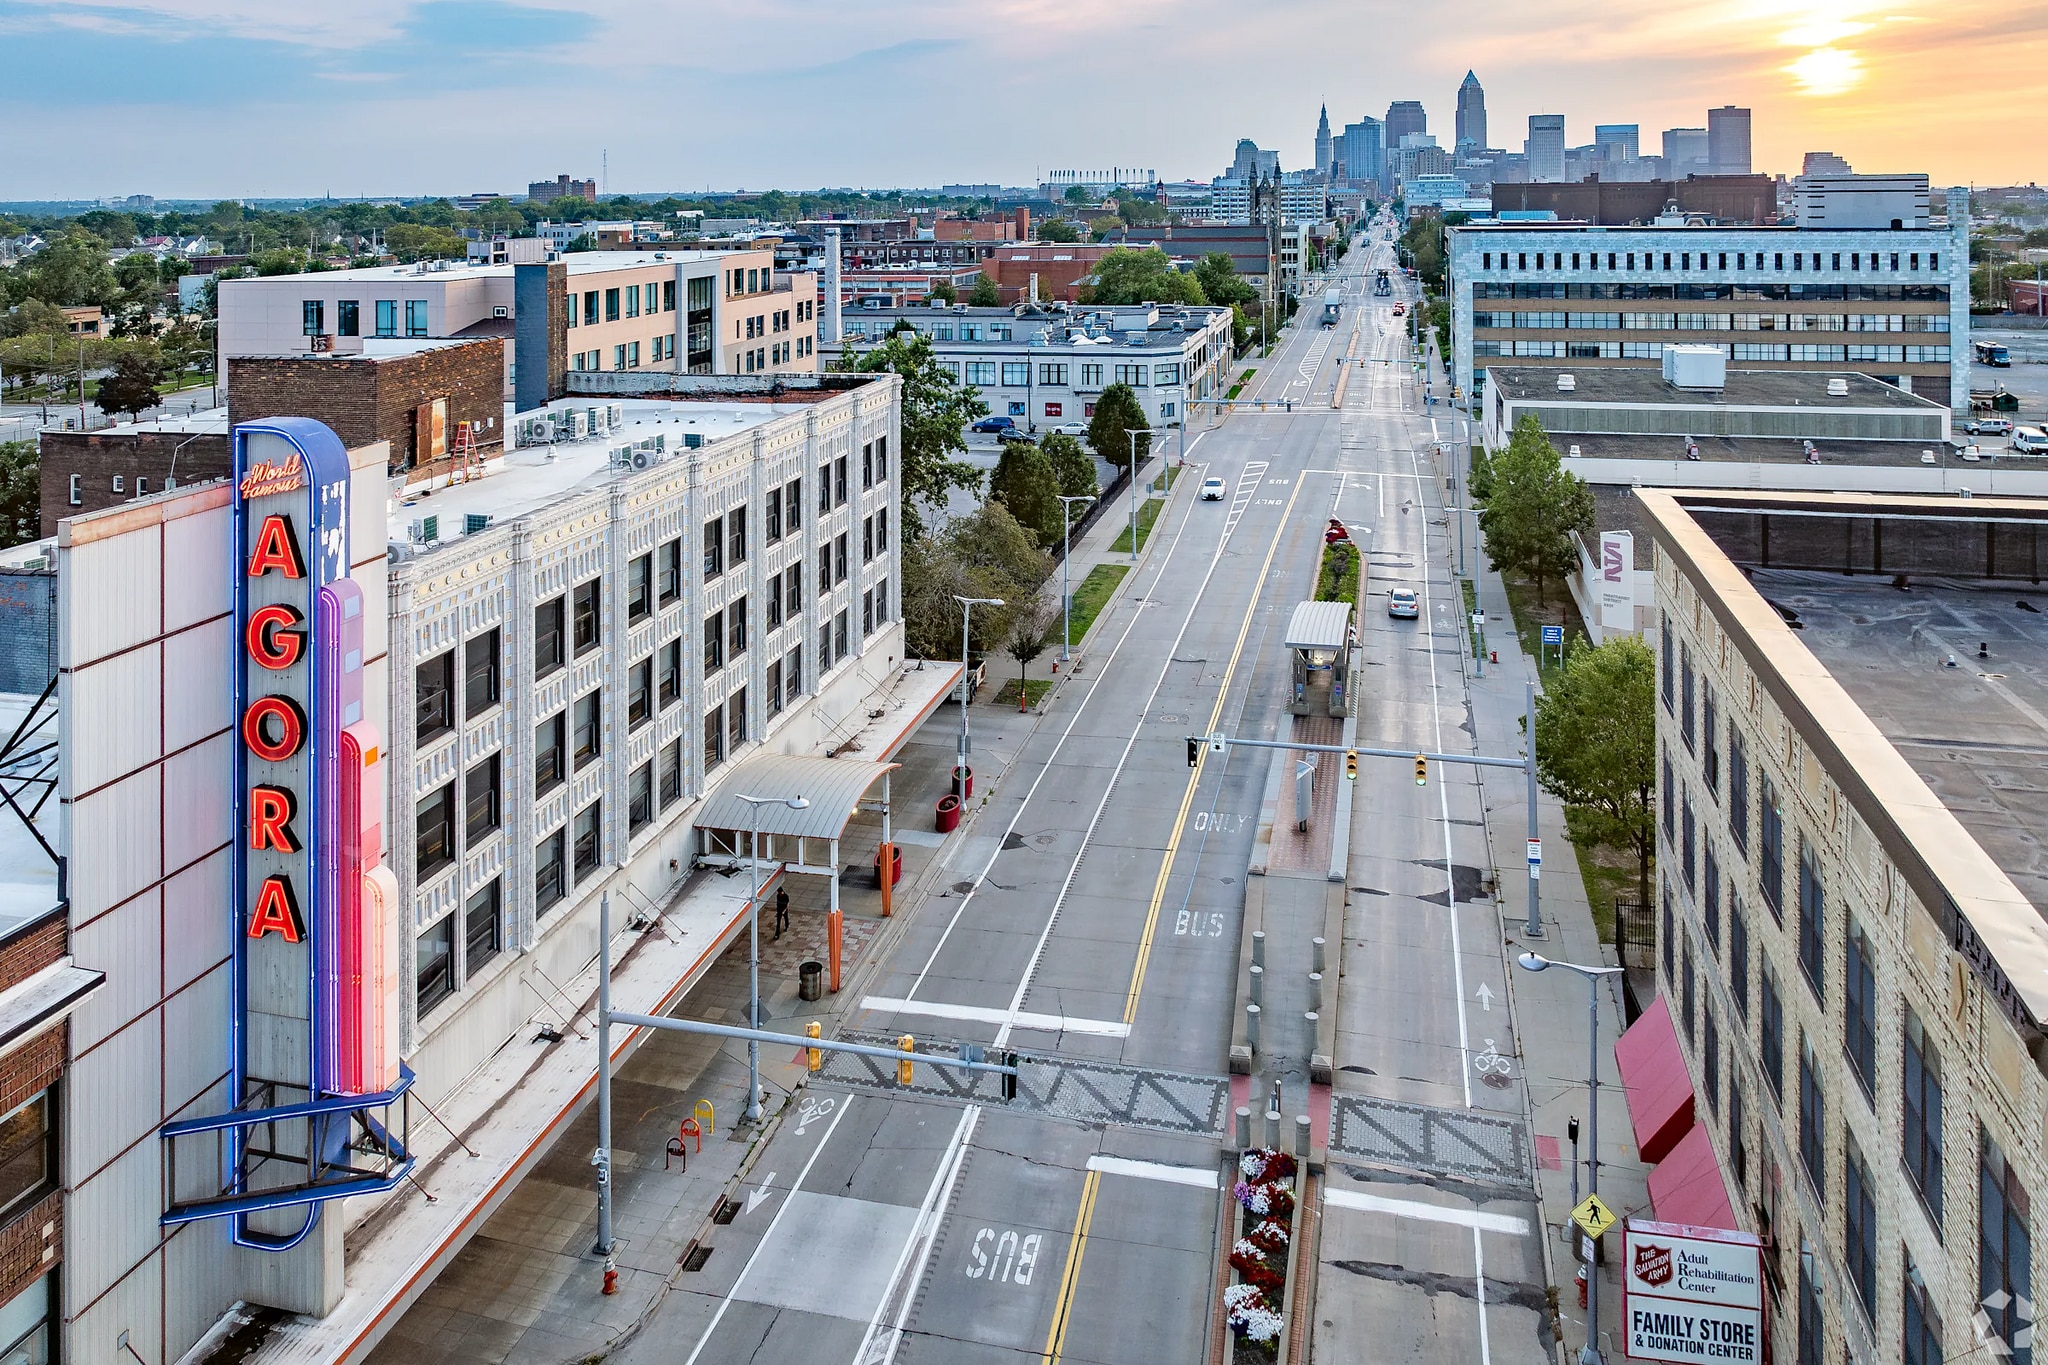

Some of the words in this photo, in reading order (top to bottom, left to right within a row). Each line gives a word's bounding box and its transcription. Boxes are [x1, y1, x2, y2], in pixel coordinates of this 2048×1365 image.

[252, 453, 301, 484] World
[240, 476, 301, 499] Famous
[244, 514, 307, 944] AGORA
[1194, 811, 1252, 834] ONLY
[1174, 909, 1224, 938] BUS
[965, 1227, 1043, 1286] BUS
[1635, 1252, 1670, 1276] SALVATION
[1640, 1248, 1657, 1261] THE
[1677, 1249, 1709, 1265] Adult
[1647, 1264, 1669, 1281] ARMY
[1678, 1262, 1754, 1285] Rehabilitation
[1677, 1277, 1717, 1294] Center
[1633, 1310, 1694, 1339] FAMILY
[1700, 1318, 1755, 1346] STORE
[1635, 1333, 1644, 1347] &
[1647, 1335, 1705, 1355] DONATION
[1708, 1342, 1754, 1361] CENTER
